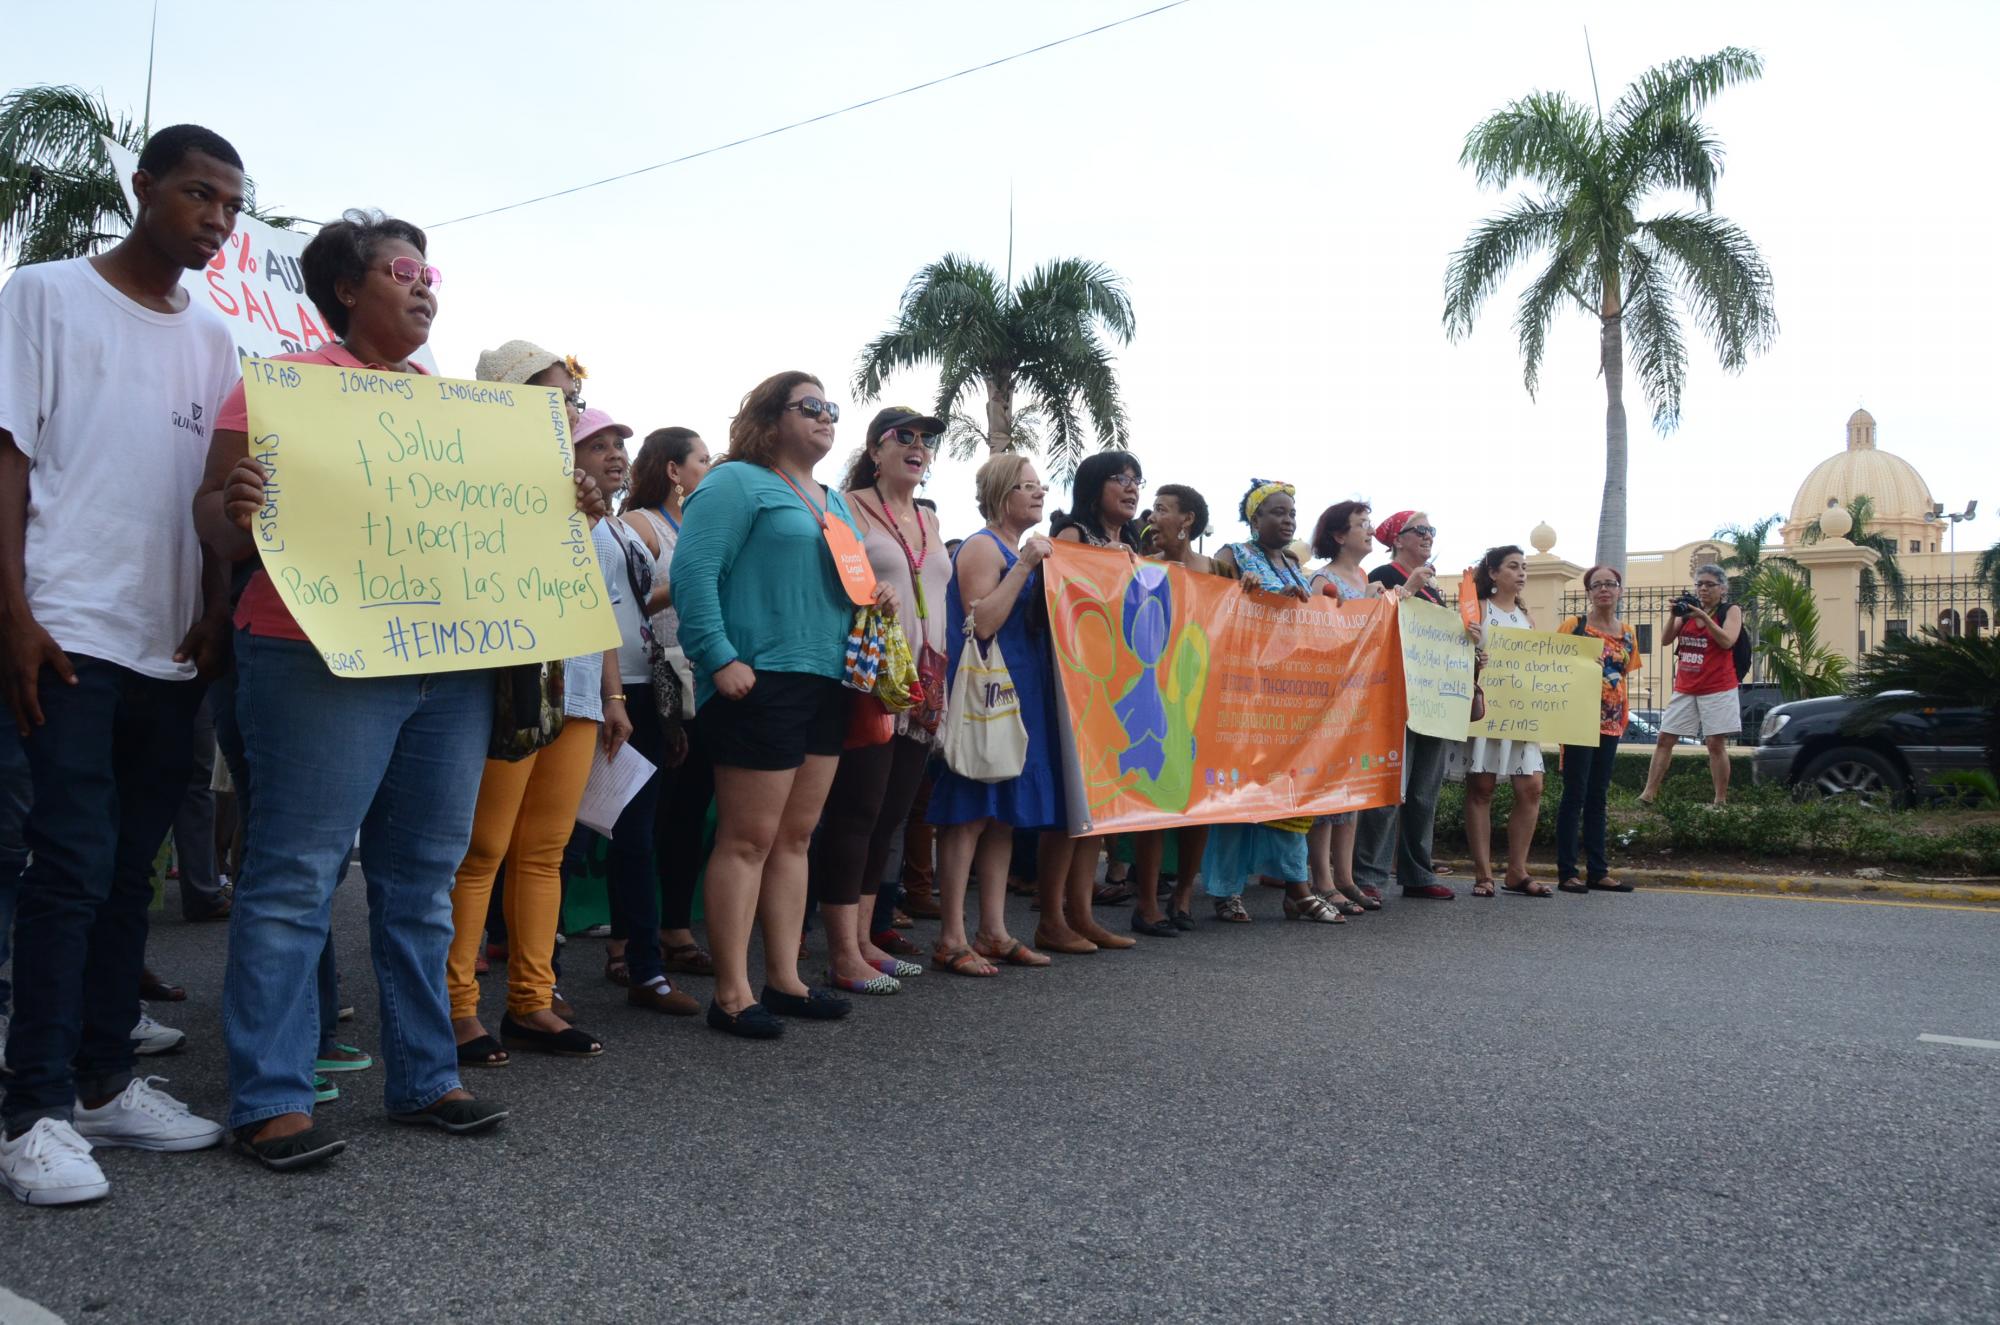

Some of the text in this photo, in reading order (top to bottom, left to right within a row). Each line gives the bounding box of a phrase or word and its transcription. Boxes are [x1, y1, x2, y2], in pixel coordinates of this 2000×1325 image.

[378, 411, 464, 464] Salud
[408, 472, 547, 515] Democracia
[281, 566, 338, 606] Para
[353, 559, 441, 602] todas
[517, 566, 599, 618] Mujeres
[383, 616, 536, 662] #EIMS2015
[1509, 699, 1525, 710] no
